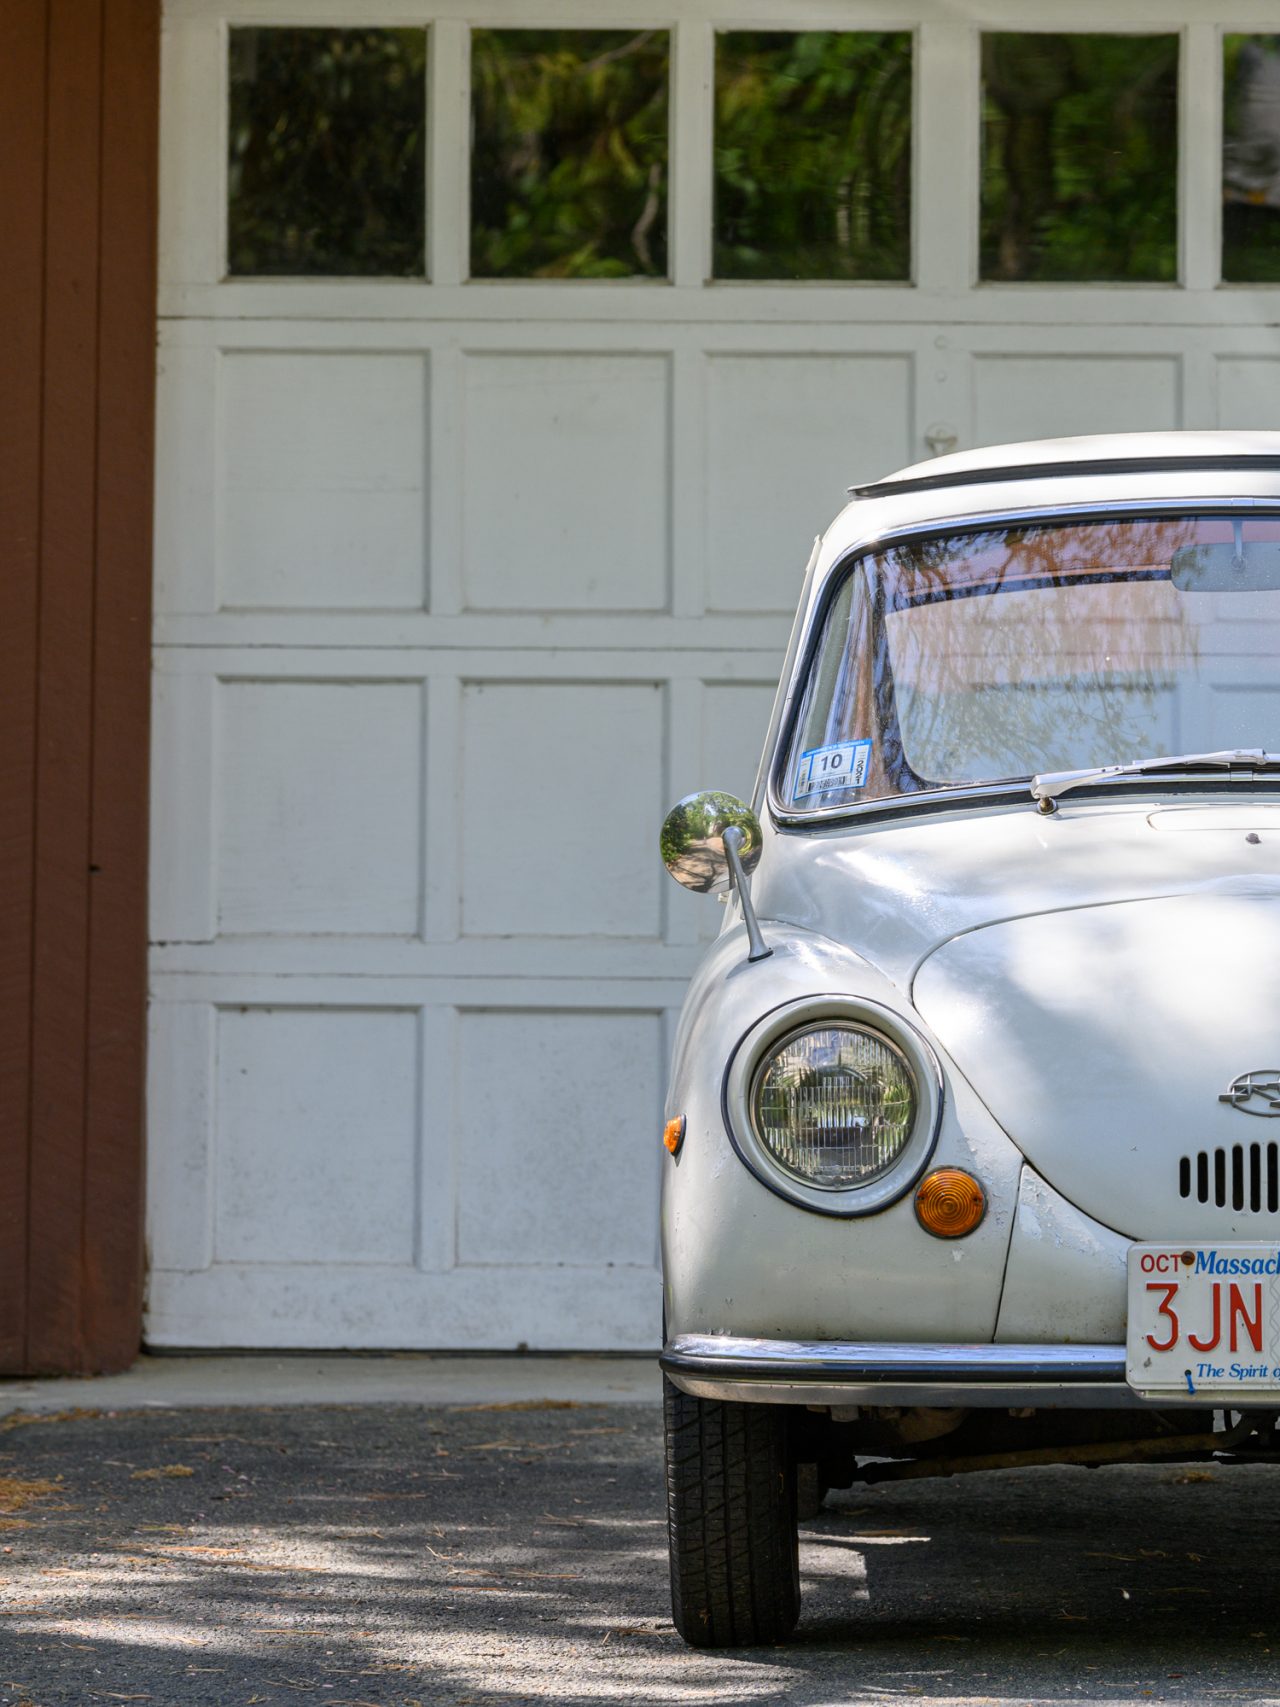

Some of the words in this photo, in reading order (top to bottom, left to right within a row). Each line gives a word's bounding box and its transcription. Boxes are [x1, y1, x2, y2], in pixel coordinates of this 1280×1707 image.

[821, 753, 843, 772] 10
[1140, 1254, 1182, 1273] OCT
[1145, 1282, 1263, 1352] 3JN
[1196, 1363, 1225, 1379] The
[1228, 1363, 1268, 1380] Spirit
